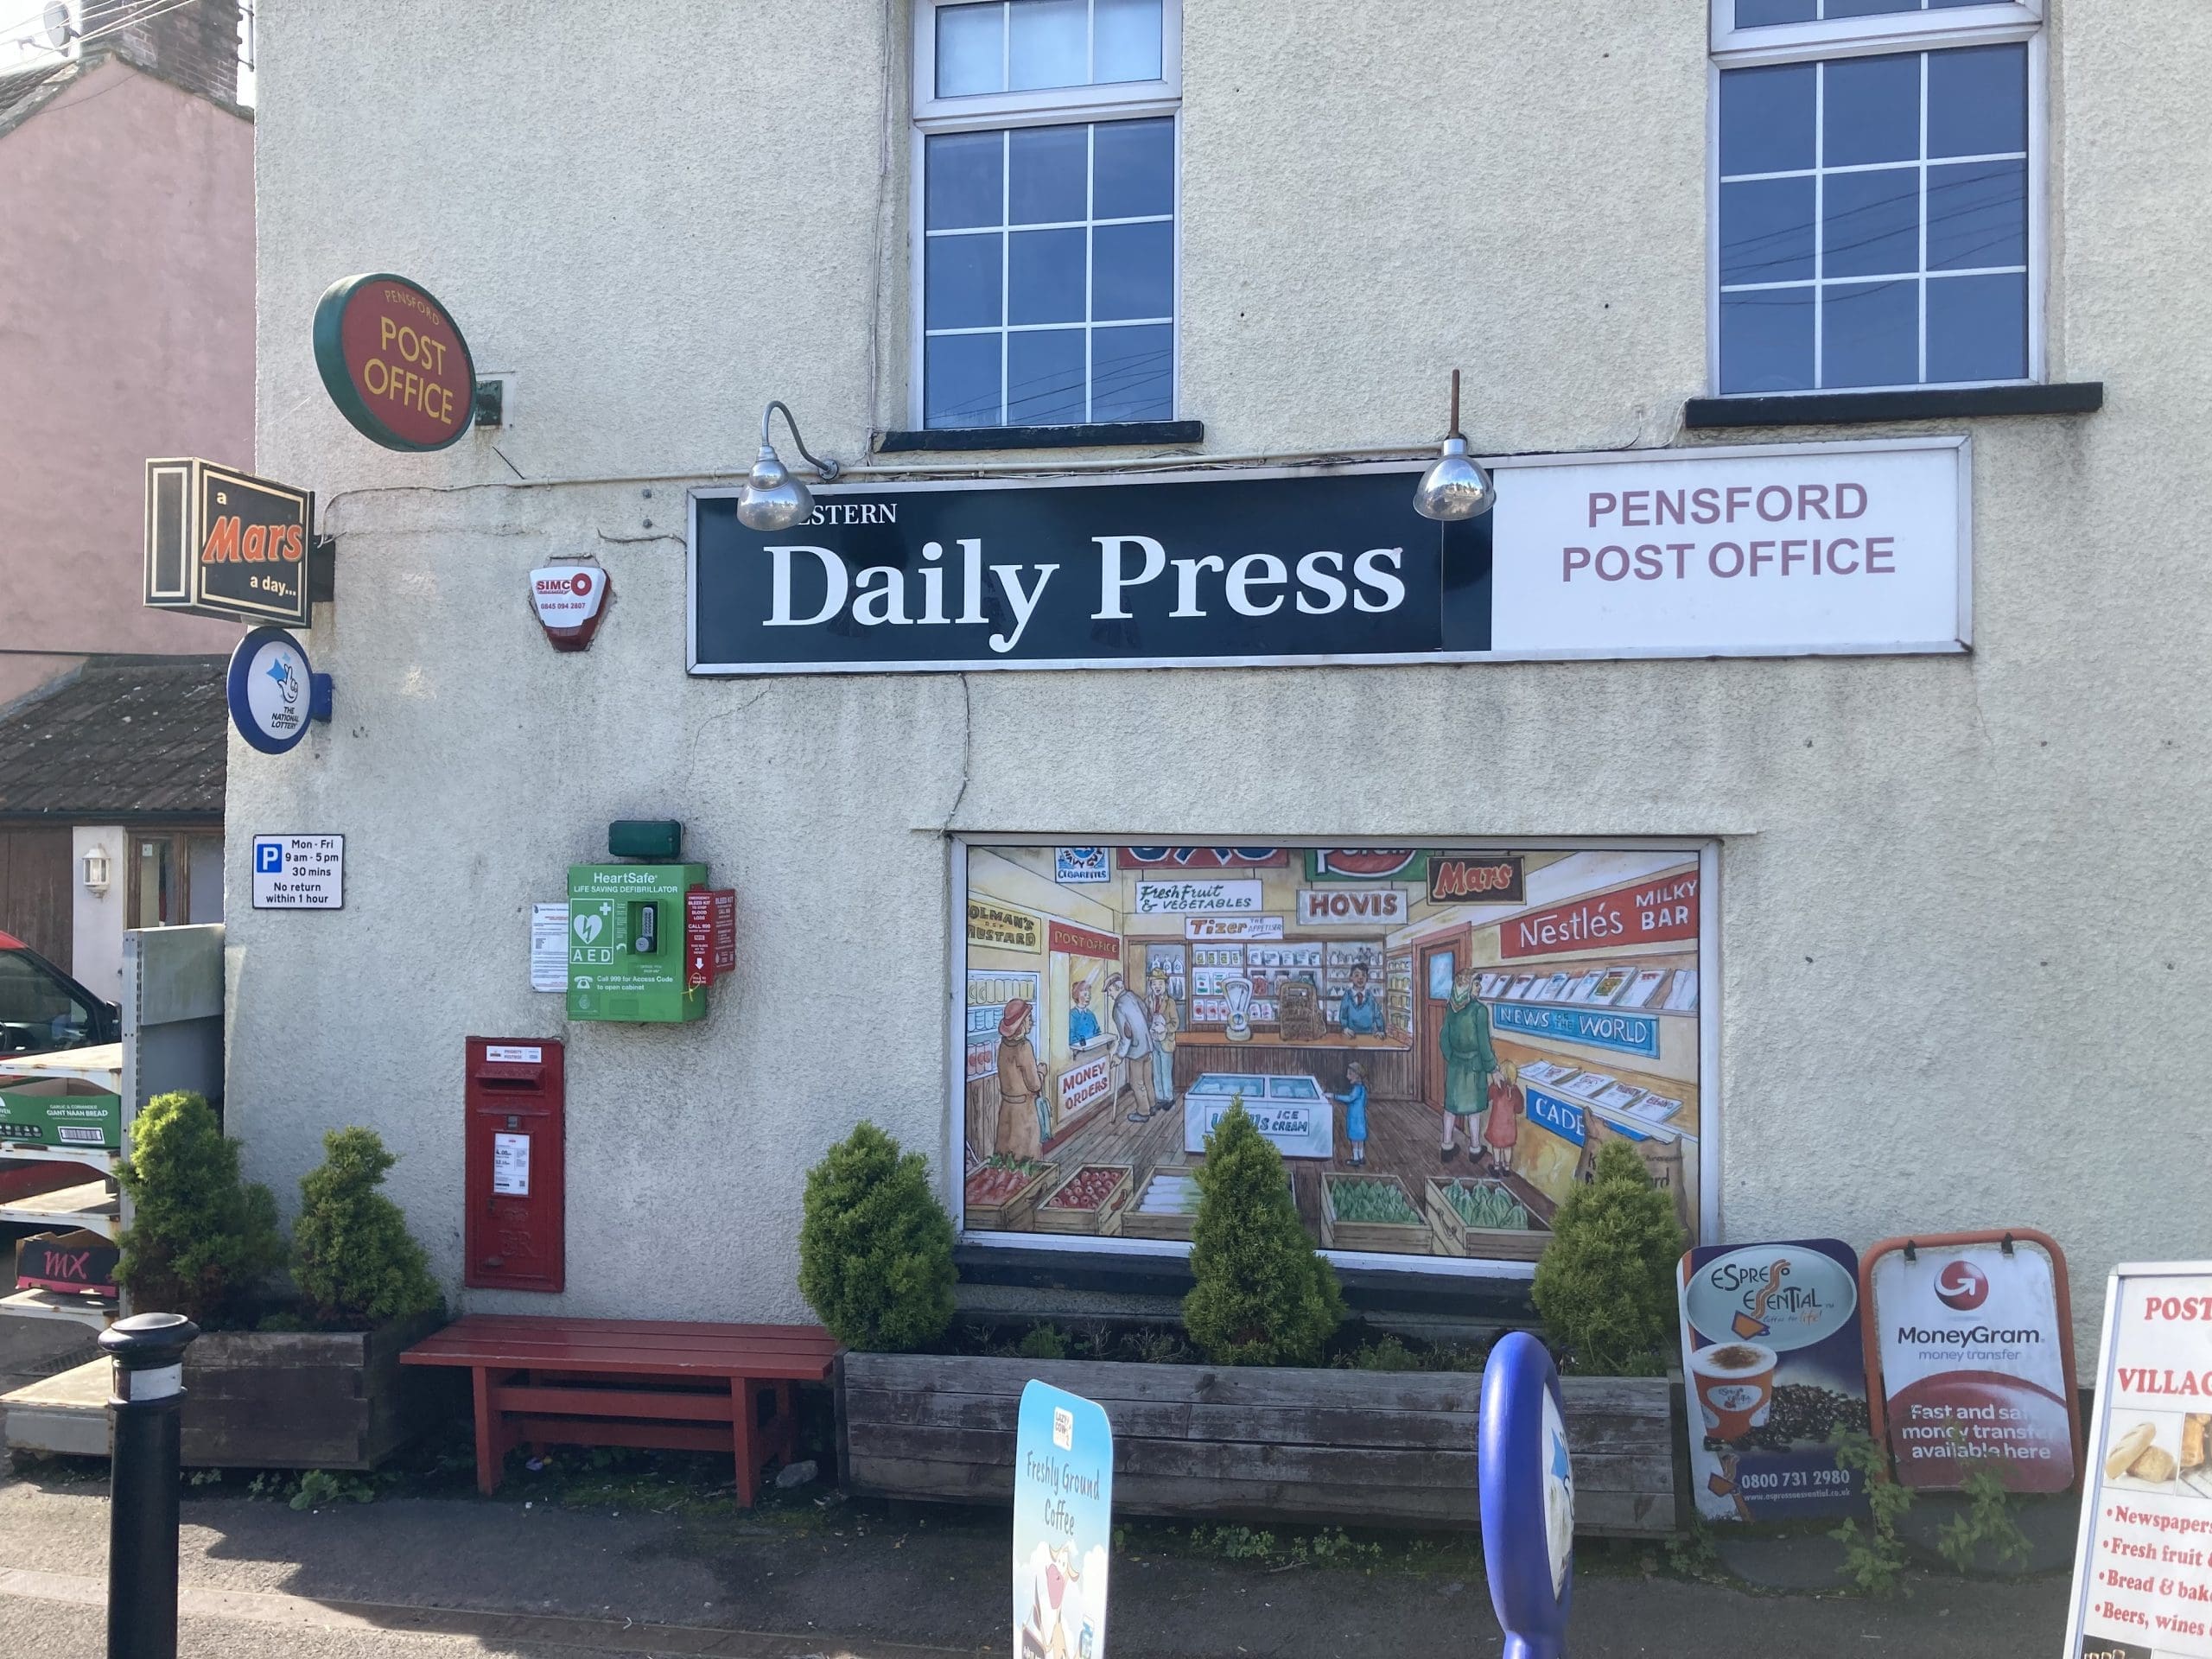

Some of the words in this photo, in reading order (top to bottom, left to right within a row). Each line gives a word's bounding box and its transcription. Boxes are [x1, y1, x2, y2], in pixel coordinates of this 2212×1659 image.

[385, 289, 439, 325] PENSFORD
[381, 316, 446, 375] POST
[364, 359, 454, 424] OFFICE
[216, 492, 227, 505] a
[1588, 483, 1868, 528] PENSFORD
[798, 504, 897, 525] STERN
[201, 516, 302, 563] Mars
[1562, 543, 1695, 582] POST
[1708, 536, 1896, 579] OFFICE
[250, 575, 257, 588] a
[537, 573, 592, 596] SIMCO
[762, 538, 1061, 654] Daily
[1090, 534, 1407, 621] Press
[271, 713, 299, 722] NATIONAL
[284, 706, 295, 715] THE
[291, 840, 312, 849] Mon
[321, 840, 334, 849] Fri
[263, 847, 278, 870] P
[285, 853, 291, 861] 9
[316, 853, 322, 861] 5
[324, 855, 339, 863] pm
[292, 868, 306, 876] 30
[308, 868, 331, 876] mins
[594, 872, 656, 883] HeartSafe
[1432, 861, 1513, 899] Mars
[274, 882, 288, 891] No
[290, 882, 321, 891] return
[1140, 886, 1180, 900] Fresh
[1181, 884, 1224, 900] Fruit
[1636, 879, 1697, 907] MILKY
[266, 894, 296, 903] within
[306, 894, 328, 903] hour
[1163, 898, 1251, 909] VEGETABLES
[1309, 893, 1398, 917] HOVIS
[968, 904, 1034, 931] OLMAN'S
[1191, 918, 1247, 935] Tizer
[1642, 906, 1688, 931] BAR
[1055, 931, 1086, 949] POST
[1086, 938, 1117, 953] OFFICE
[605, 984, 620, 993] open
[1500, 1007, 1550, 1027] NEWS
[1579, 1015, 1647, 1044] WORLD
[1063, 1062, 1105, 1094] MONEY
[1065, 1077, 1108, 1109] ORDERS
[1272, 1121, 1308, 1132] CREAM
[1277, 1110, 1299, 1120] ICE
[2145, 1297, 2212, 1320] POST
[1897, 1325, 2040, 1348] MoneyGram
[1918, 1350, 1965, 1363] money
[1966, 1348, 2021, 1360] transfer
[1910, 1404, 1952, 1420] Fast
[1956, 1403, 1995, 1420] and
[1911, 1442, 2000, 1459] available
[2004, 1442, 2051, 1459] here
[1027, 1450, 1059, 1496] Freshly
[1062, 1462, 1100, 1501] Ground
[1741, 1473, 1778, 1489] 0800
[1782, 1471, 1807, 1487] 731
[1813, 1469, 1851, 1485] 2980
[1045, 1497, 1075, 1536] Coffee
[2110, 1537, 2158, 1560] Fresh
[2161, 1545, 2203, 1567] fruit
[2107, 1569, 2155, 1593] Bread
[2159, 1578, 2175, 1596] &
[2102, 1601, 2150, 1630] Beers,
[2155, 1614, 2205, 1637] wines
